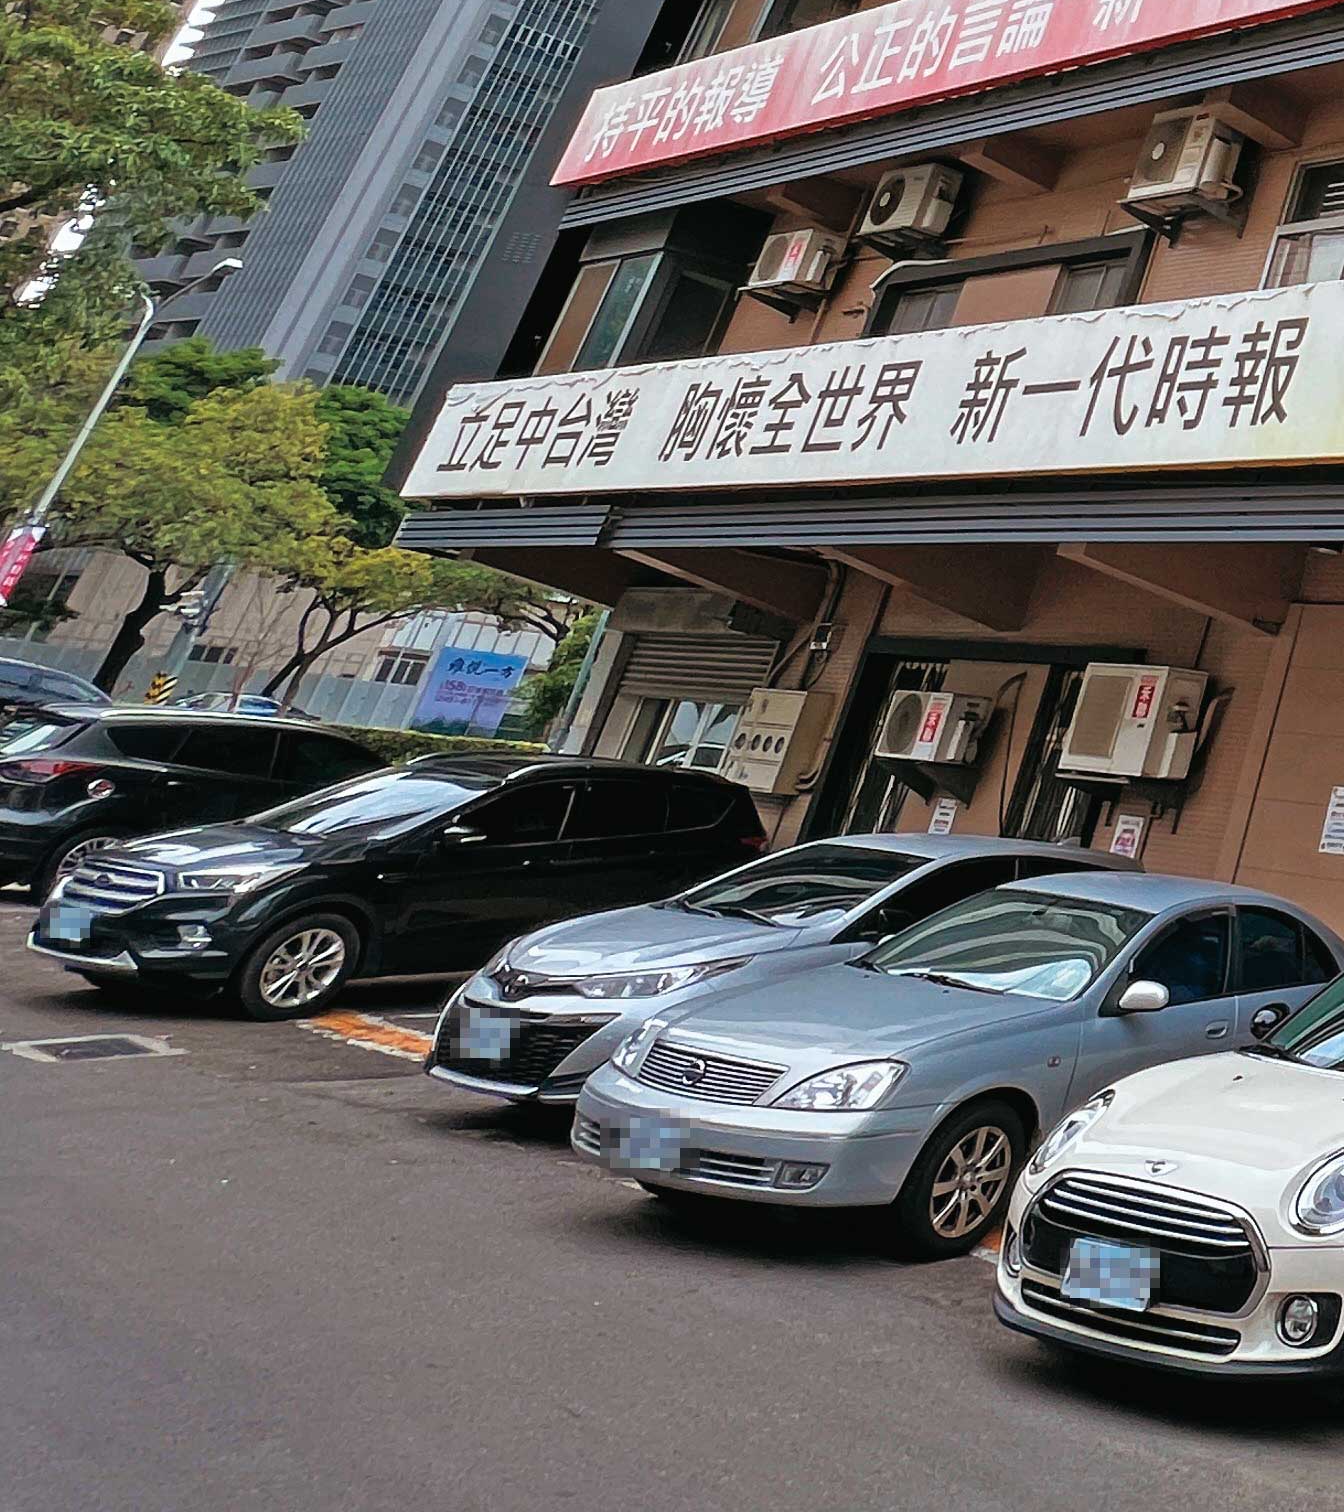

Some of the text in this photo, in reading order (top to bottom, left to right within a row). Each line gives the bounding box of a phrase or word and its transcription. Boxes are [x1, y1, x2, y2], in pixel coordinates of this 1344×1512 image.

[584, 55, 785, 163] 持平的報導
[436, 388, 641, 475] 立足中台灣
[656, 359, 925, 464] 胸懷全世界
[947, 317, 1308, 441] 新一代時報
